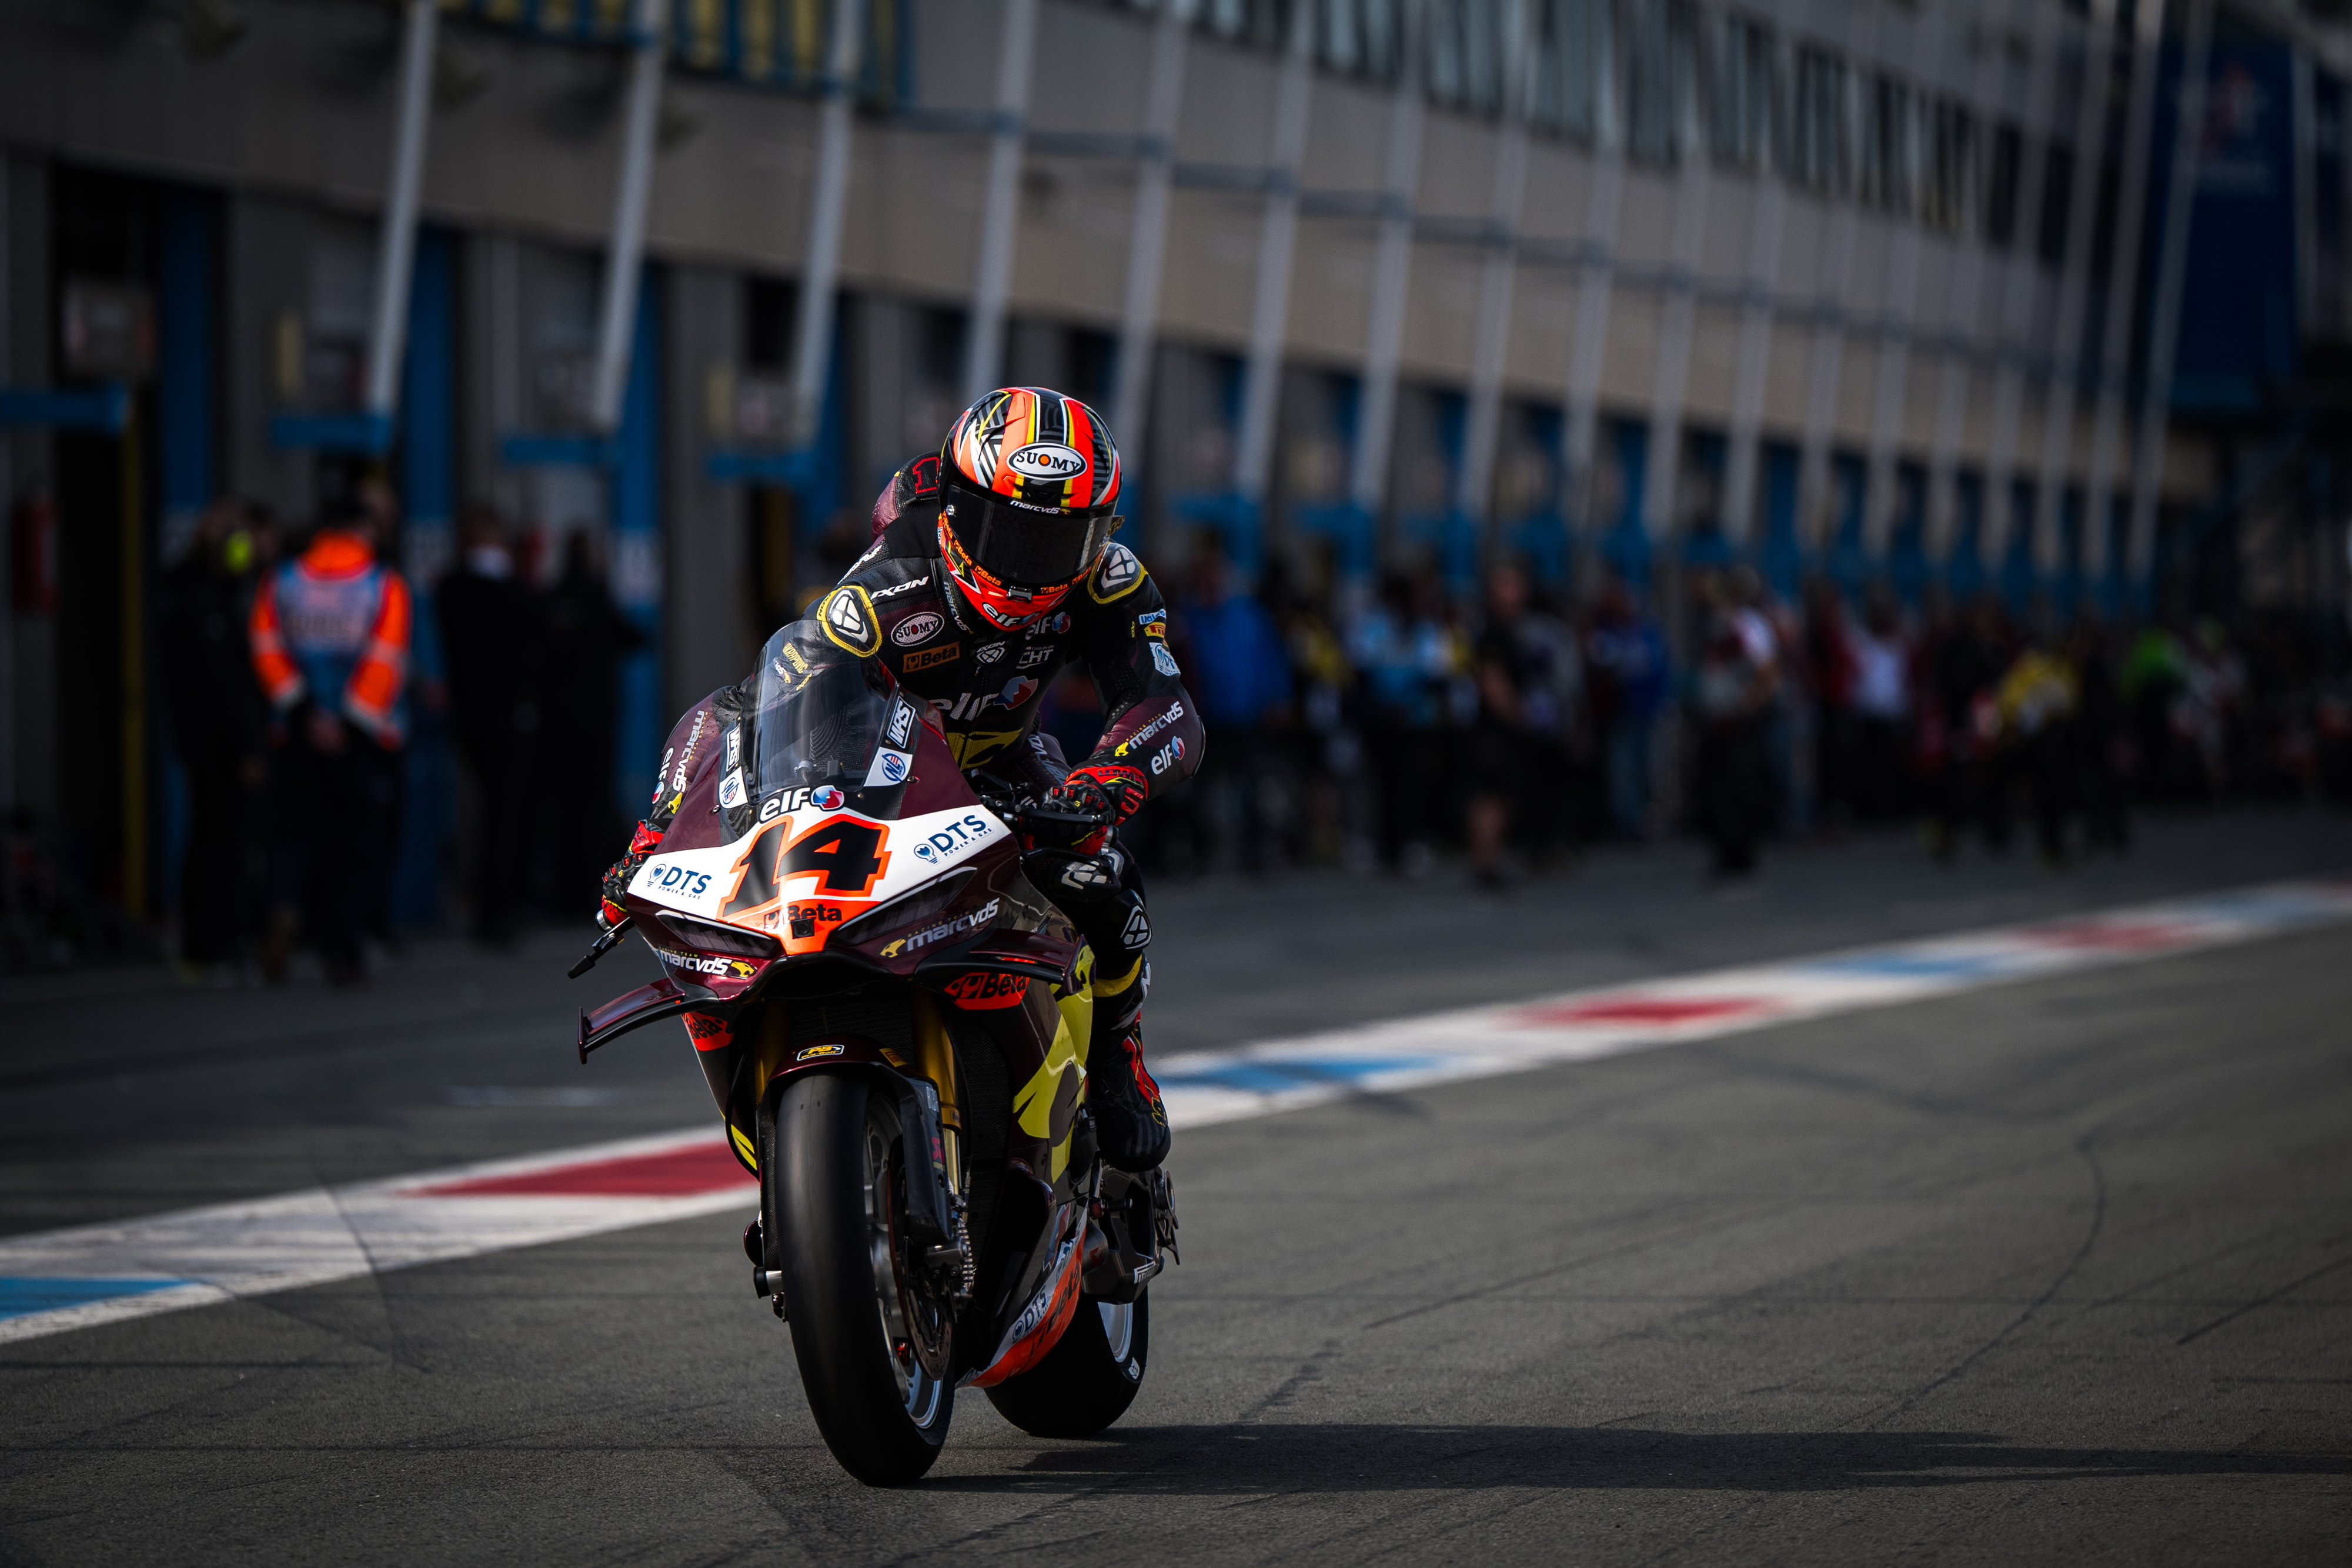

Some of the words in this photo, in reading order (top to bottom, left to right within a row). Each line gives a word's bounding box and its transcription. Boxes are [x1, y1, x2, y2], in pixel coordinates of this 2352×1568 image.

[1016, 451, 1080, 474] SUOMY
[957, 547, 973, 566] Beta
[870, 576, 929, 600] IXON
[980, 571, 1002, 586] Beta
[1049, 584, 1068, 593] Beta
[983, 603, 1021, 627] elf
[896, 619, 939, 638] SUOMY
[1025, 616, 1052, 640] elf
[921, 646, 957, 666] Beta
[890, 701, 910, 744] WRS
[659, 748, 674, 780] elf
[1151, 744, 1172, 775] elf
[763, 787, 811, 821] elf
[928, 815, 986, 852] DTS
[944, 841, 969, 857] POWER
[978, 828, 992, 837] GAS
[661, 867, 711, 894] DTS
[719, 817, 889, 920] 14
[658, 886, 679, 894] POWER
[788, 904, 842, 921] Beta
[908, 921, 943, 938] RACING
[948, 911, 970, 922] TEAM
[979, 974, 1027, 999] Beta
